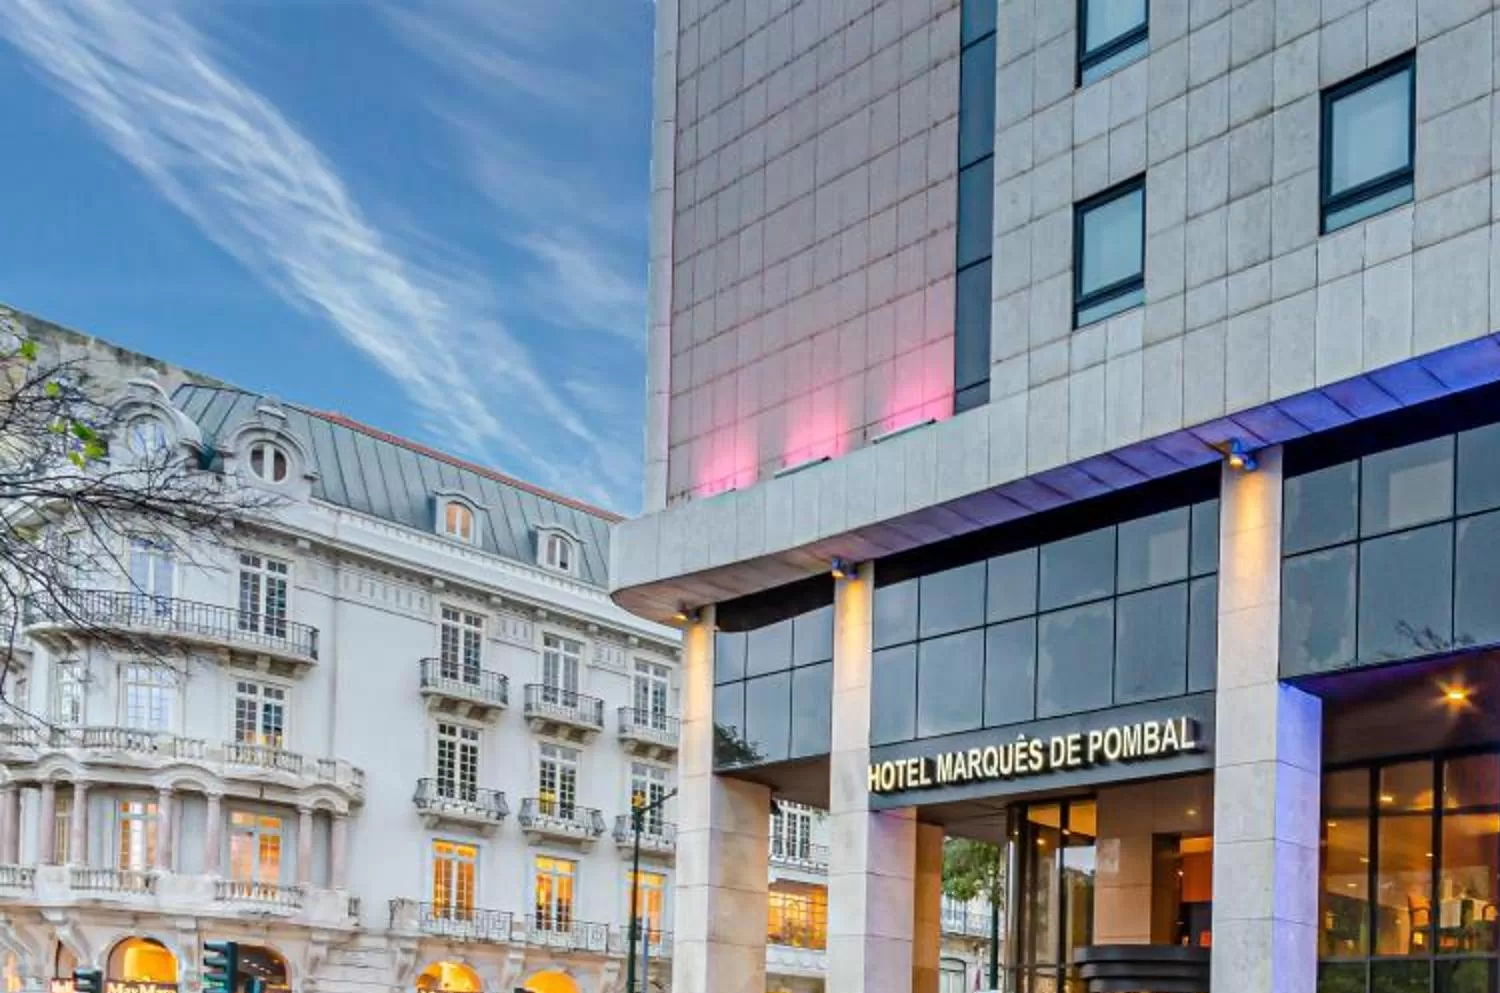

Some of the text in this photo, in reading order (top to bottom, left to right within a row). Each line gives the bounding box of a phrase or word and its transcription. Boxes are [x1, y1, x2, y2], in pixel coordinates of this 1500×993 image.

[868, 716, 1196, 792] HOTEL MARQUÊS DE POMBAL
